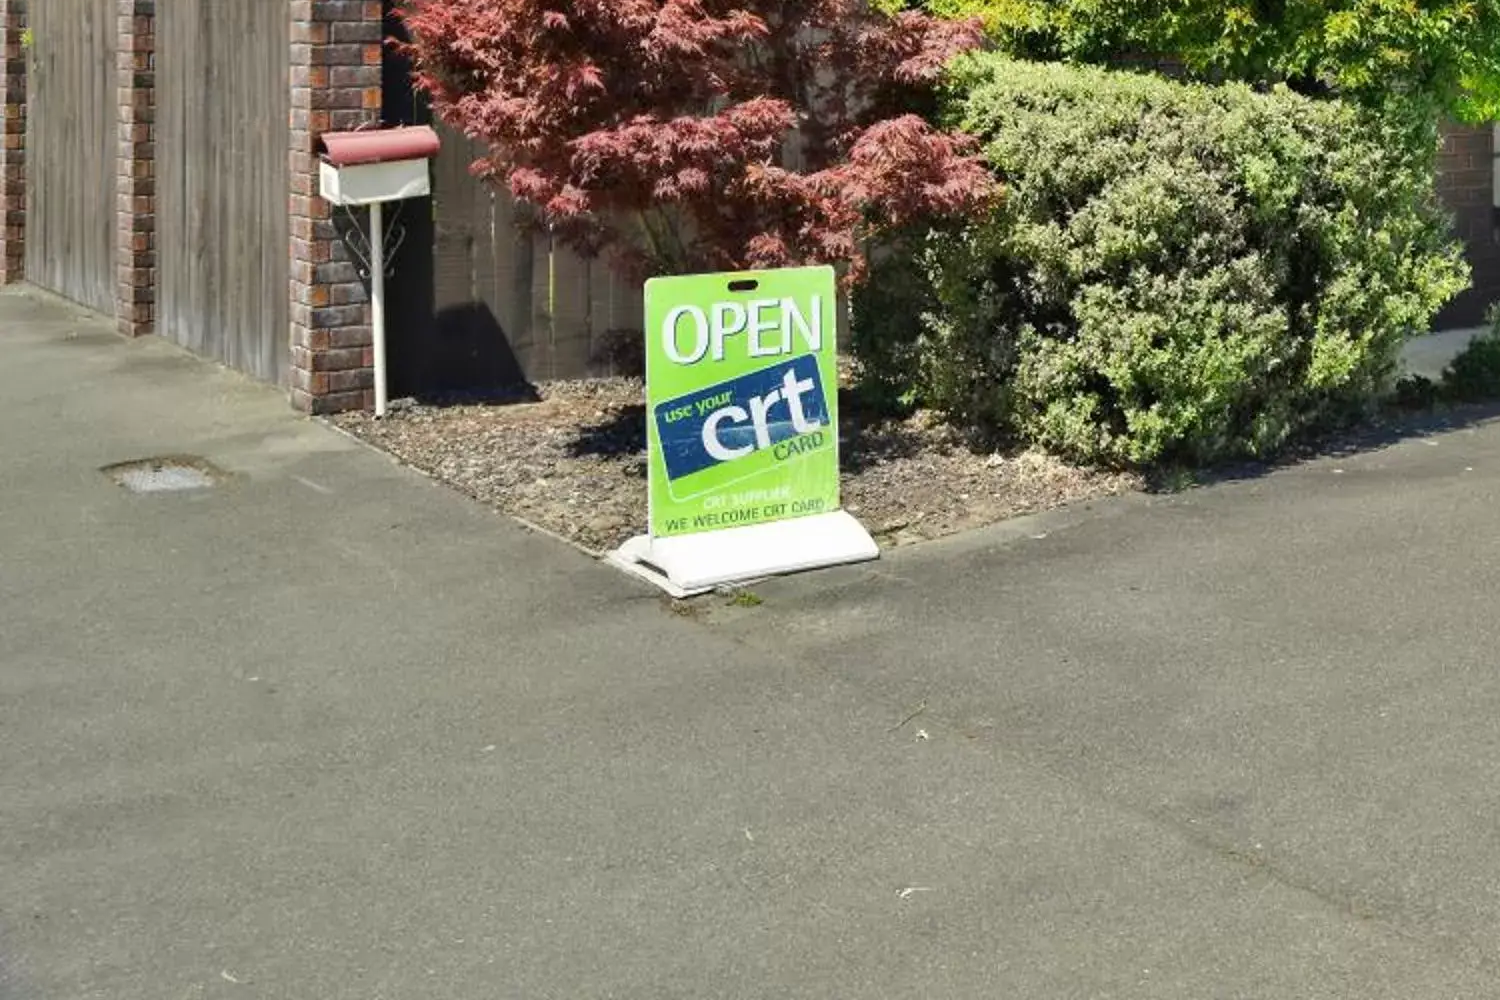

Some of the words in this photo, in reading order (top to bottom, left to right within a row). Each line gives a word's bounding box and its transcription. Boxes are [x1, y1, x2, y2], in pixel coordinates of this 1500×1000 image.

[661, 294, 824, 365] OPEN
[665, 403, 692, 423] use
[695, 391, 733, 416] your
[702, 367, 821, 461] crt
[773, 431, 824, 461] CARD
[665, 518, 688, 531] WE
[692, 508, 759, 528] WELCOME
[763, 503, 786, 518] CRT
[791, 498, 826, 513] CARD
